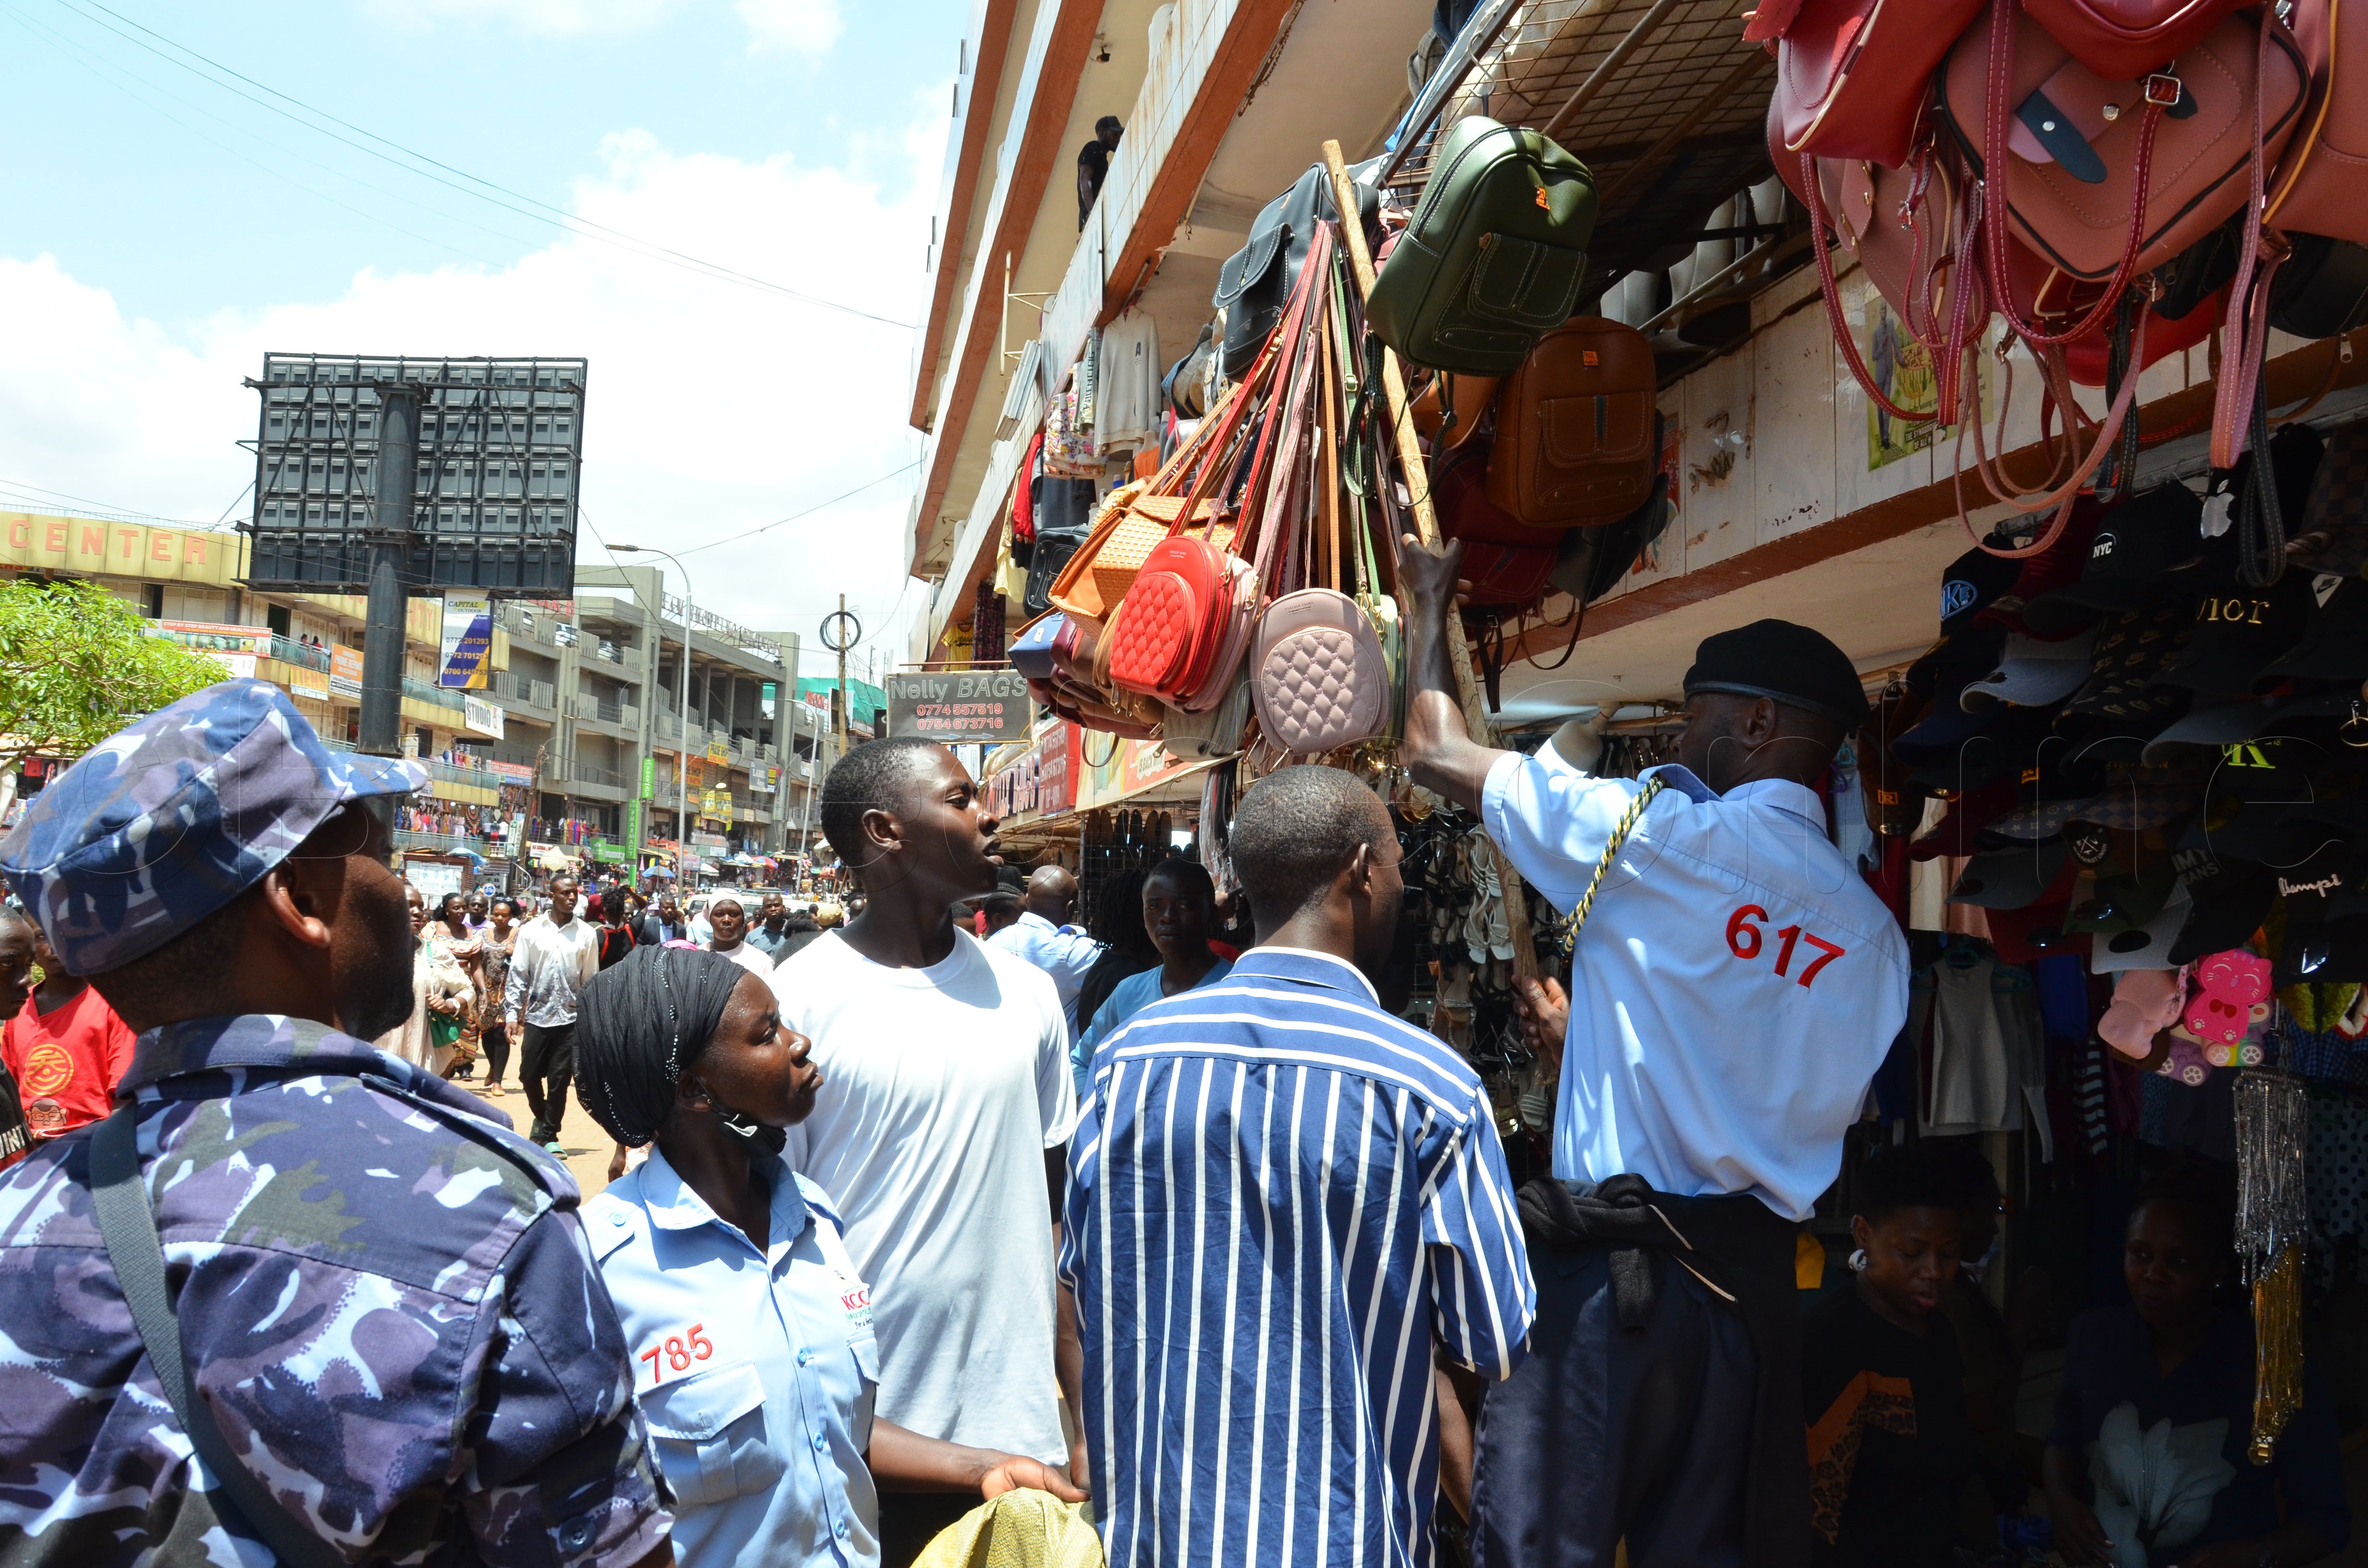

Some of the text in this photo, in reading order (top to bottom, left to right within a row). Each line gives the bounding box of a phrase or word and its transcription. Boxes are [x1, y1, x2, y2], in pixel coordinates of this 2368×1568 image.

[9, 519, 206, 564] CENTER
[2092, 541, 2112, 558] NYC
[292, 665, 327, 691] TIENS
[890, 676, 1027, 702] Nelly BAGS
[467, 701, 491, 728] STUDIO
[917, 703, 1003, 716] 0774 557519
[917, 717, 1004, 730] 0754 673716
[1726, 904, 1845, 989] 617
[641, 1323, 713, 1384] 785
